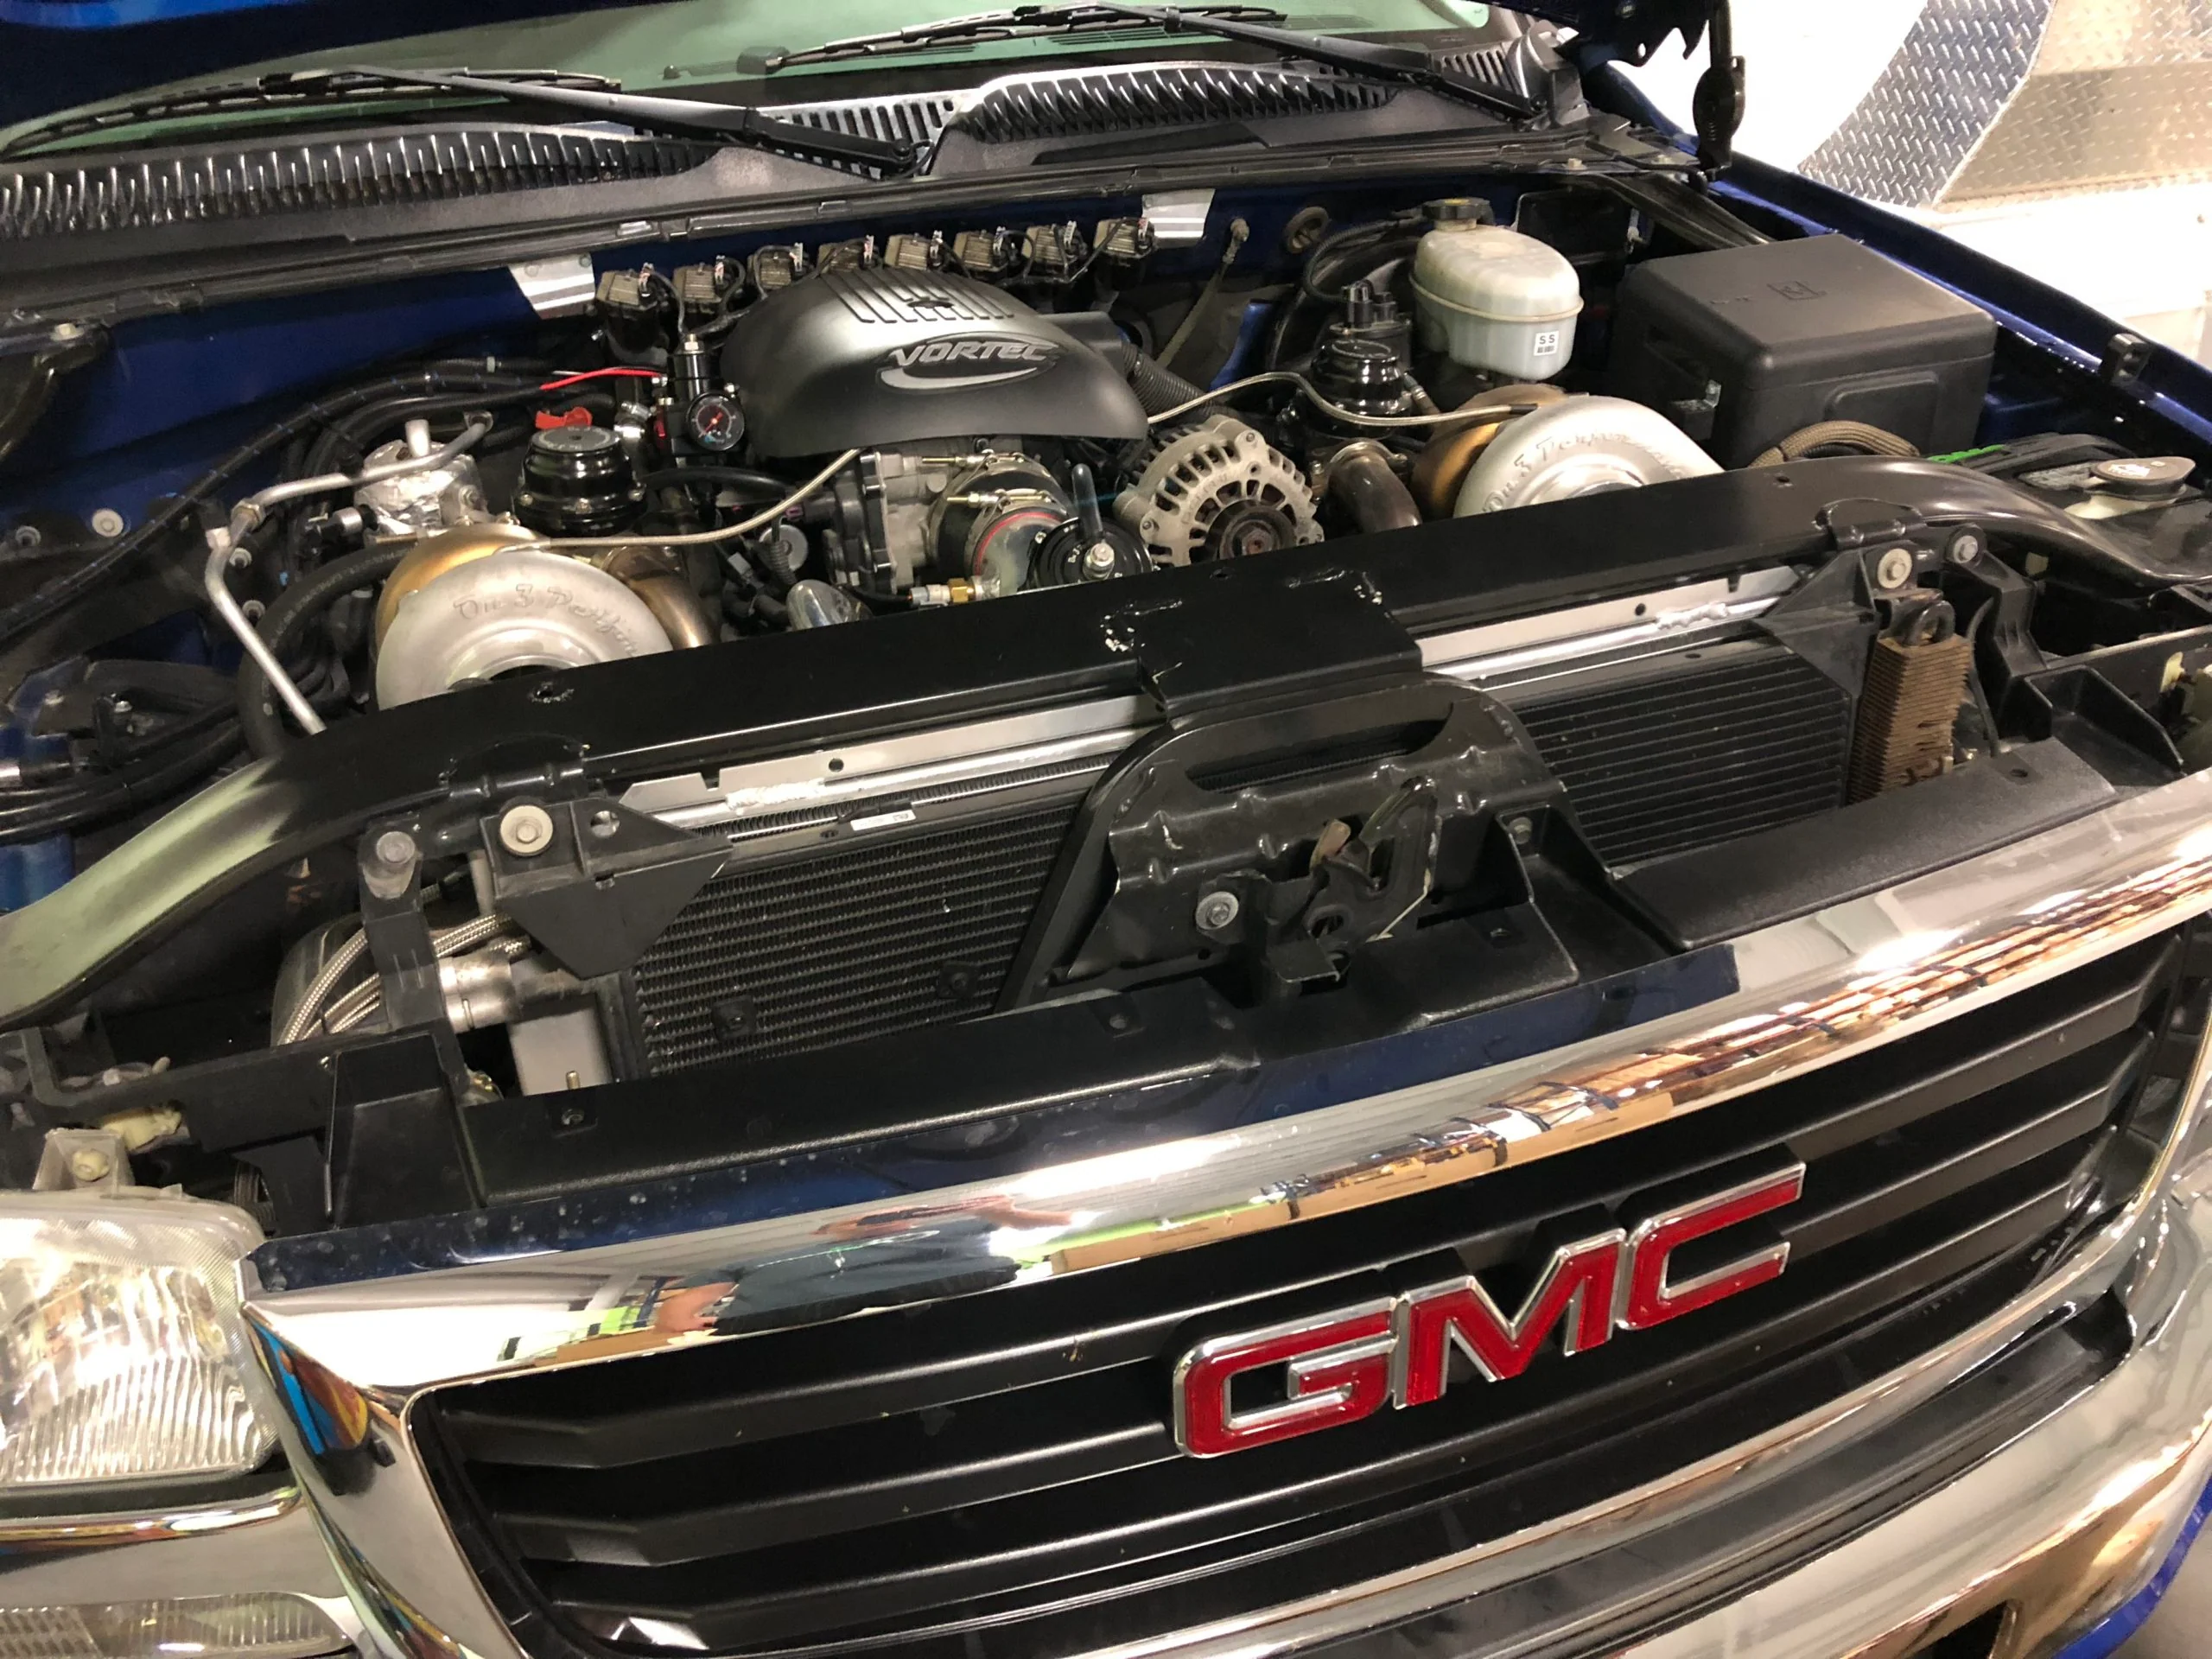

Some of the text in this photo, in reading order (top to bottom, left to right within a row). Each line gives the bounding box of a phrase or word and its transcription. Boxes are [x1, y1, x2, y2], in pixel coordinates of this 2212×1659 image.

[888, 340, 1053, 366] VORTEC
[515, 582, 535, 608] 3
[1173, 1161, 1806, 1459] GMC
